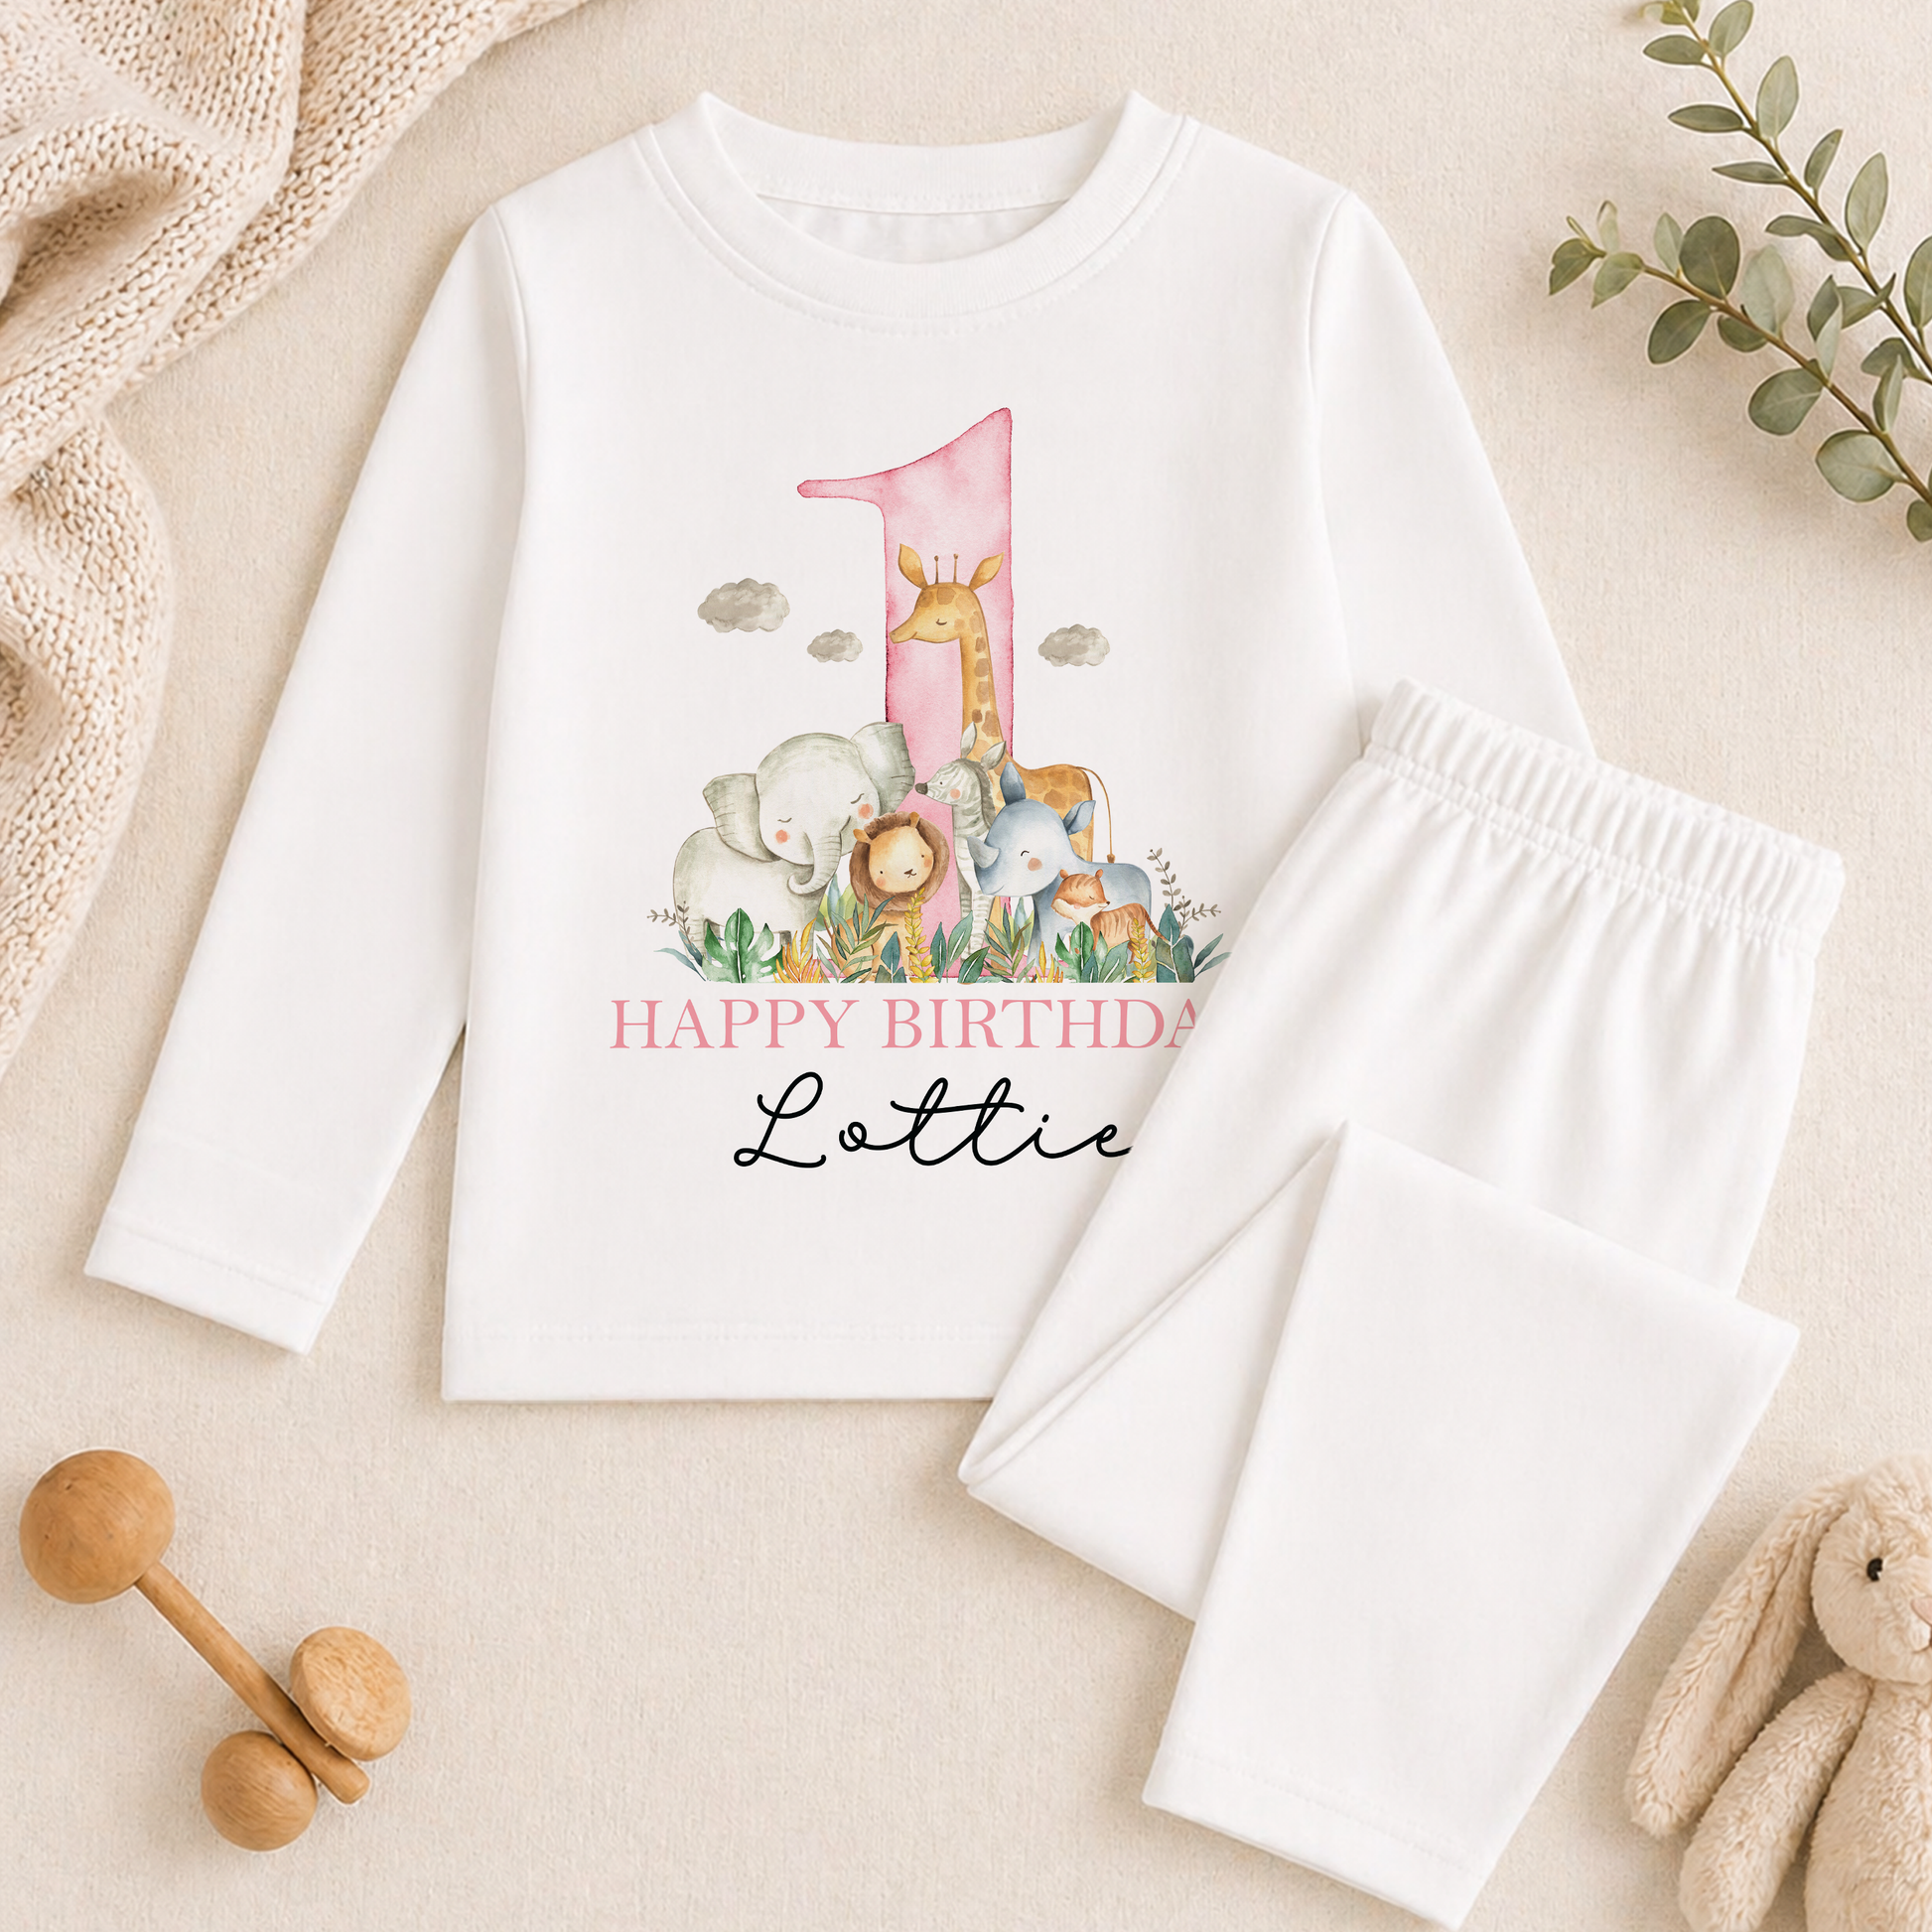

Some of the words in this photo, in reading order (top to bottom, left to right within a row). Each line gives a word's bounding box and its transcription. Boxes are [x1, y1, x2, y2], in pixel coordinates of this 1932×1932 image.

[796, 406, 1068, 979] 1
[610, 998, 861, 1049] HAPPY
[882, 998, 1197, 1049] BIRTHDA
[733, 1071, 1134, 1169] Lottie
